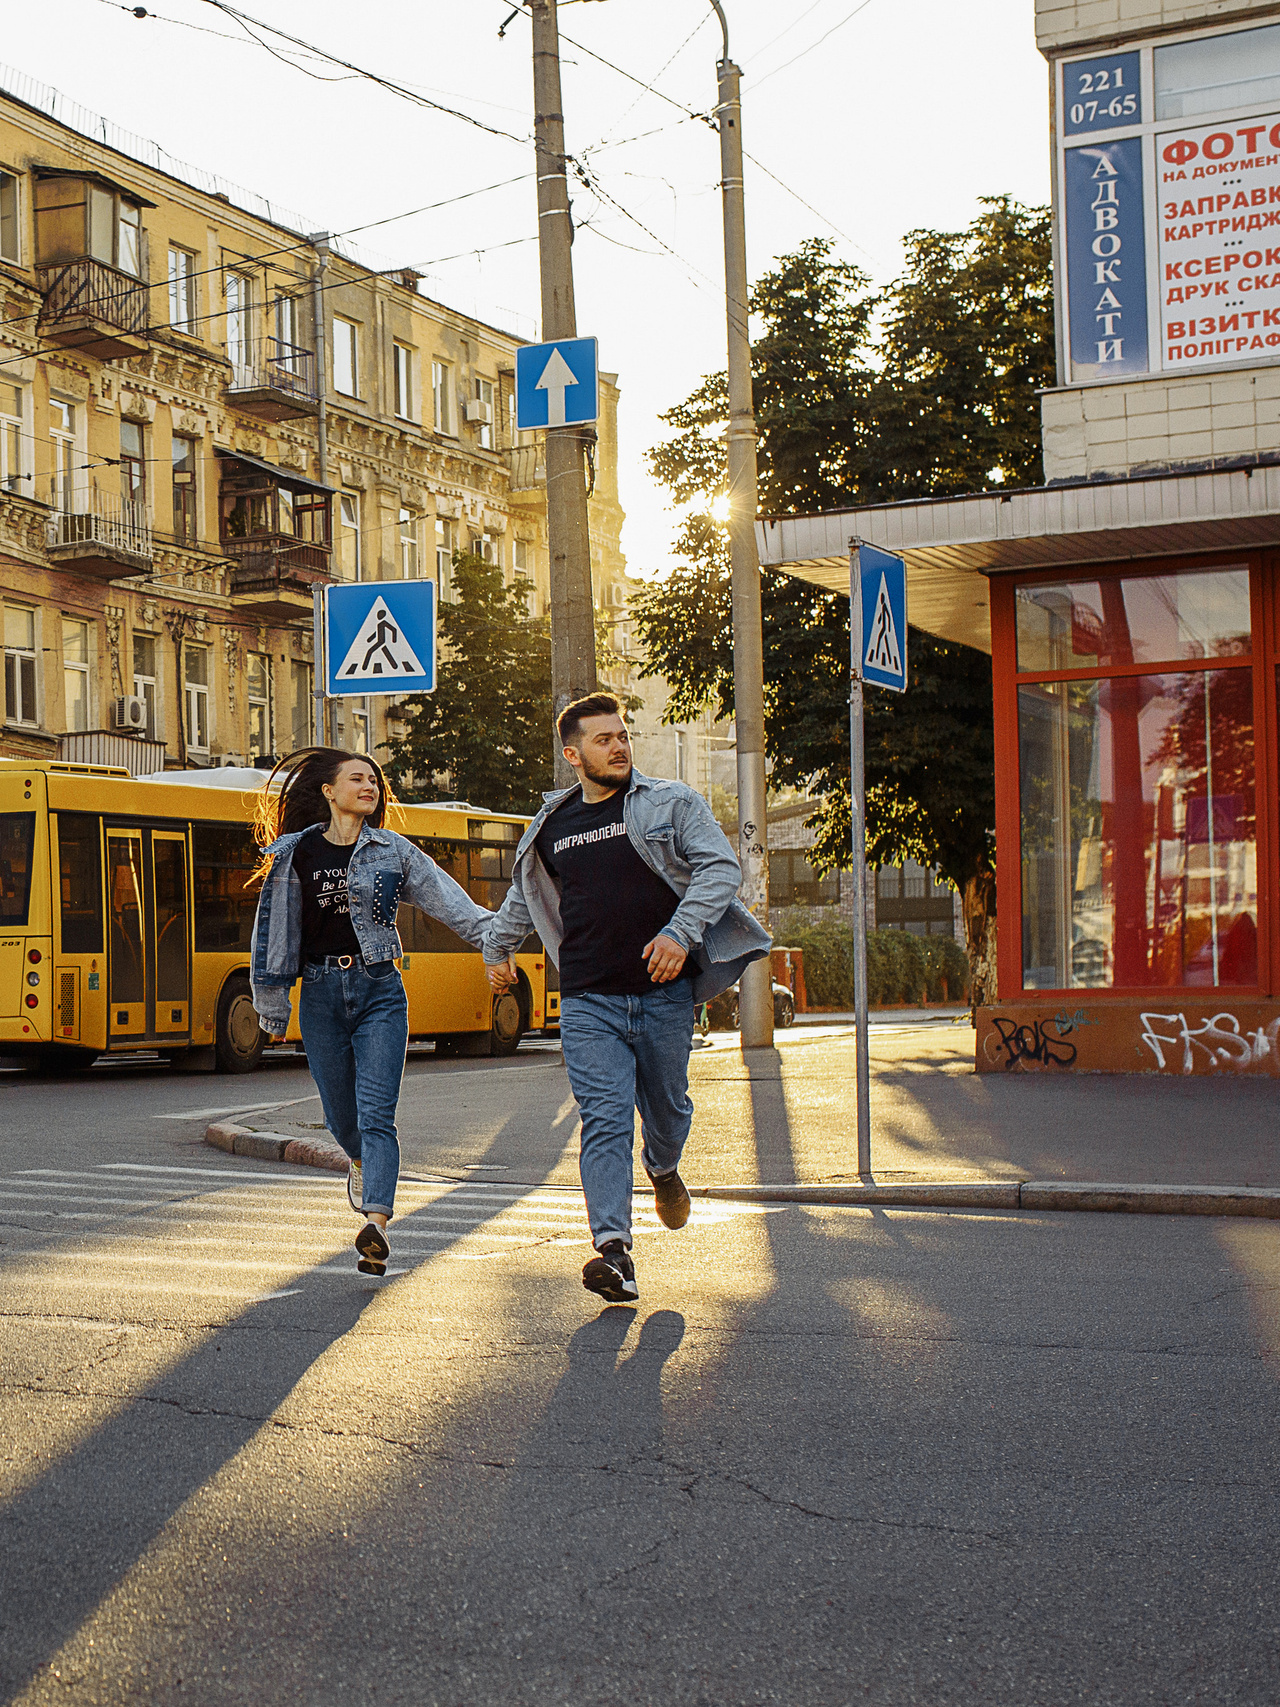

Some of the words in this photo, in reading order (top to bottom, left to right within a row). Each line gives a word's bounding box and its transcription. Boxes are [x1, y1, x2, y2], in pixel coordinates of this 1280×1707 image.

[1079, 67, 1125, 95] 221
[1070, 93, 1137, 124] 07-65
[1163, 170, 1187, 183] НА
[1192, 154, 1280, 180] ДОКУМЕН
[1164, 210, 1280, 242] КАРТРИДЖ
[1091, 155, 1124, 364] АДВОКАТИ
[1165, 246, 1280, 281] КСЕРОК
[1166, 280, 1230, 306] ДРУК
[1167, 307, 1280, 340] ВІЗИТК
[1168, 332, 1280, 361] ПОЛІГРАФ
[313, 870, 322, 880] IF
[324, 868, 347, 877] YOU
[322, 881, 335, 891] Be
[318, 897, 331, 909] BE
